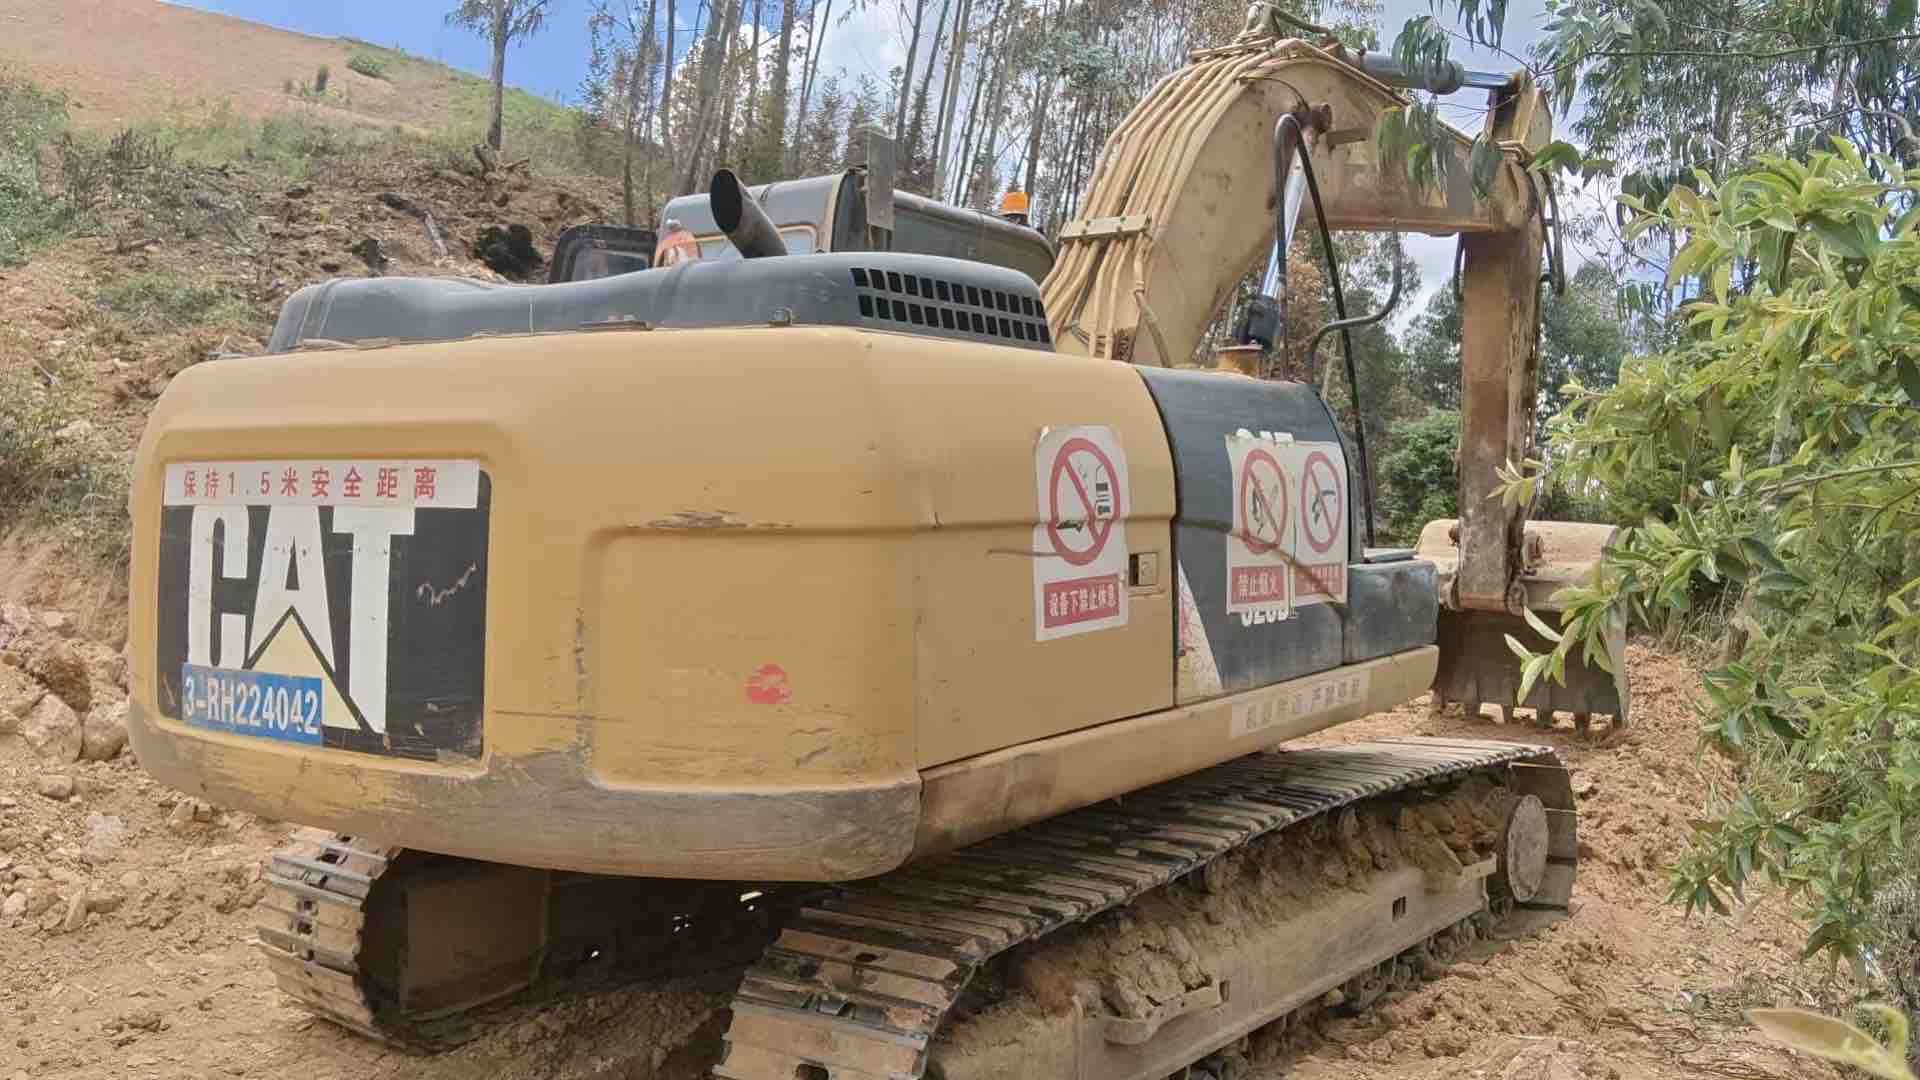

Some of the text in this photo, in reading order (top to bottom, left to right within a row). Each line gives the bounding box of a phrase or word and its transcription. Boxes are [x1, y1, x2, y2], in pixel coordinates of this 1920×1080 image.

[183, 465, 436, 499] 保持1.5米安全距离
[187, 505, 415, 735] CAT
[183, 675, 320, 735] 3-RH224042
